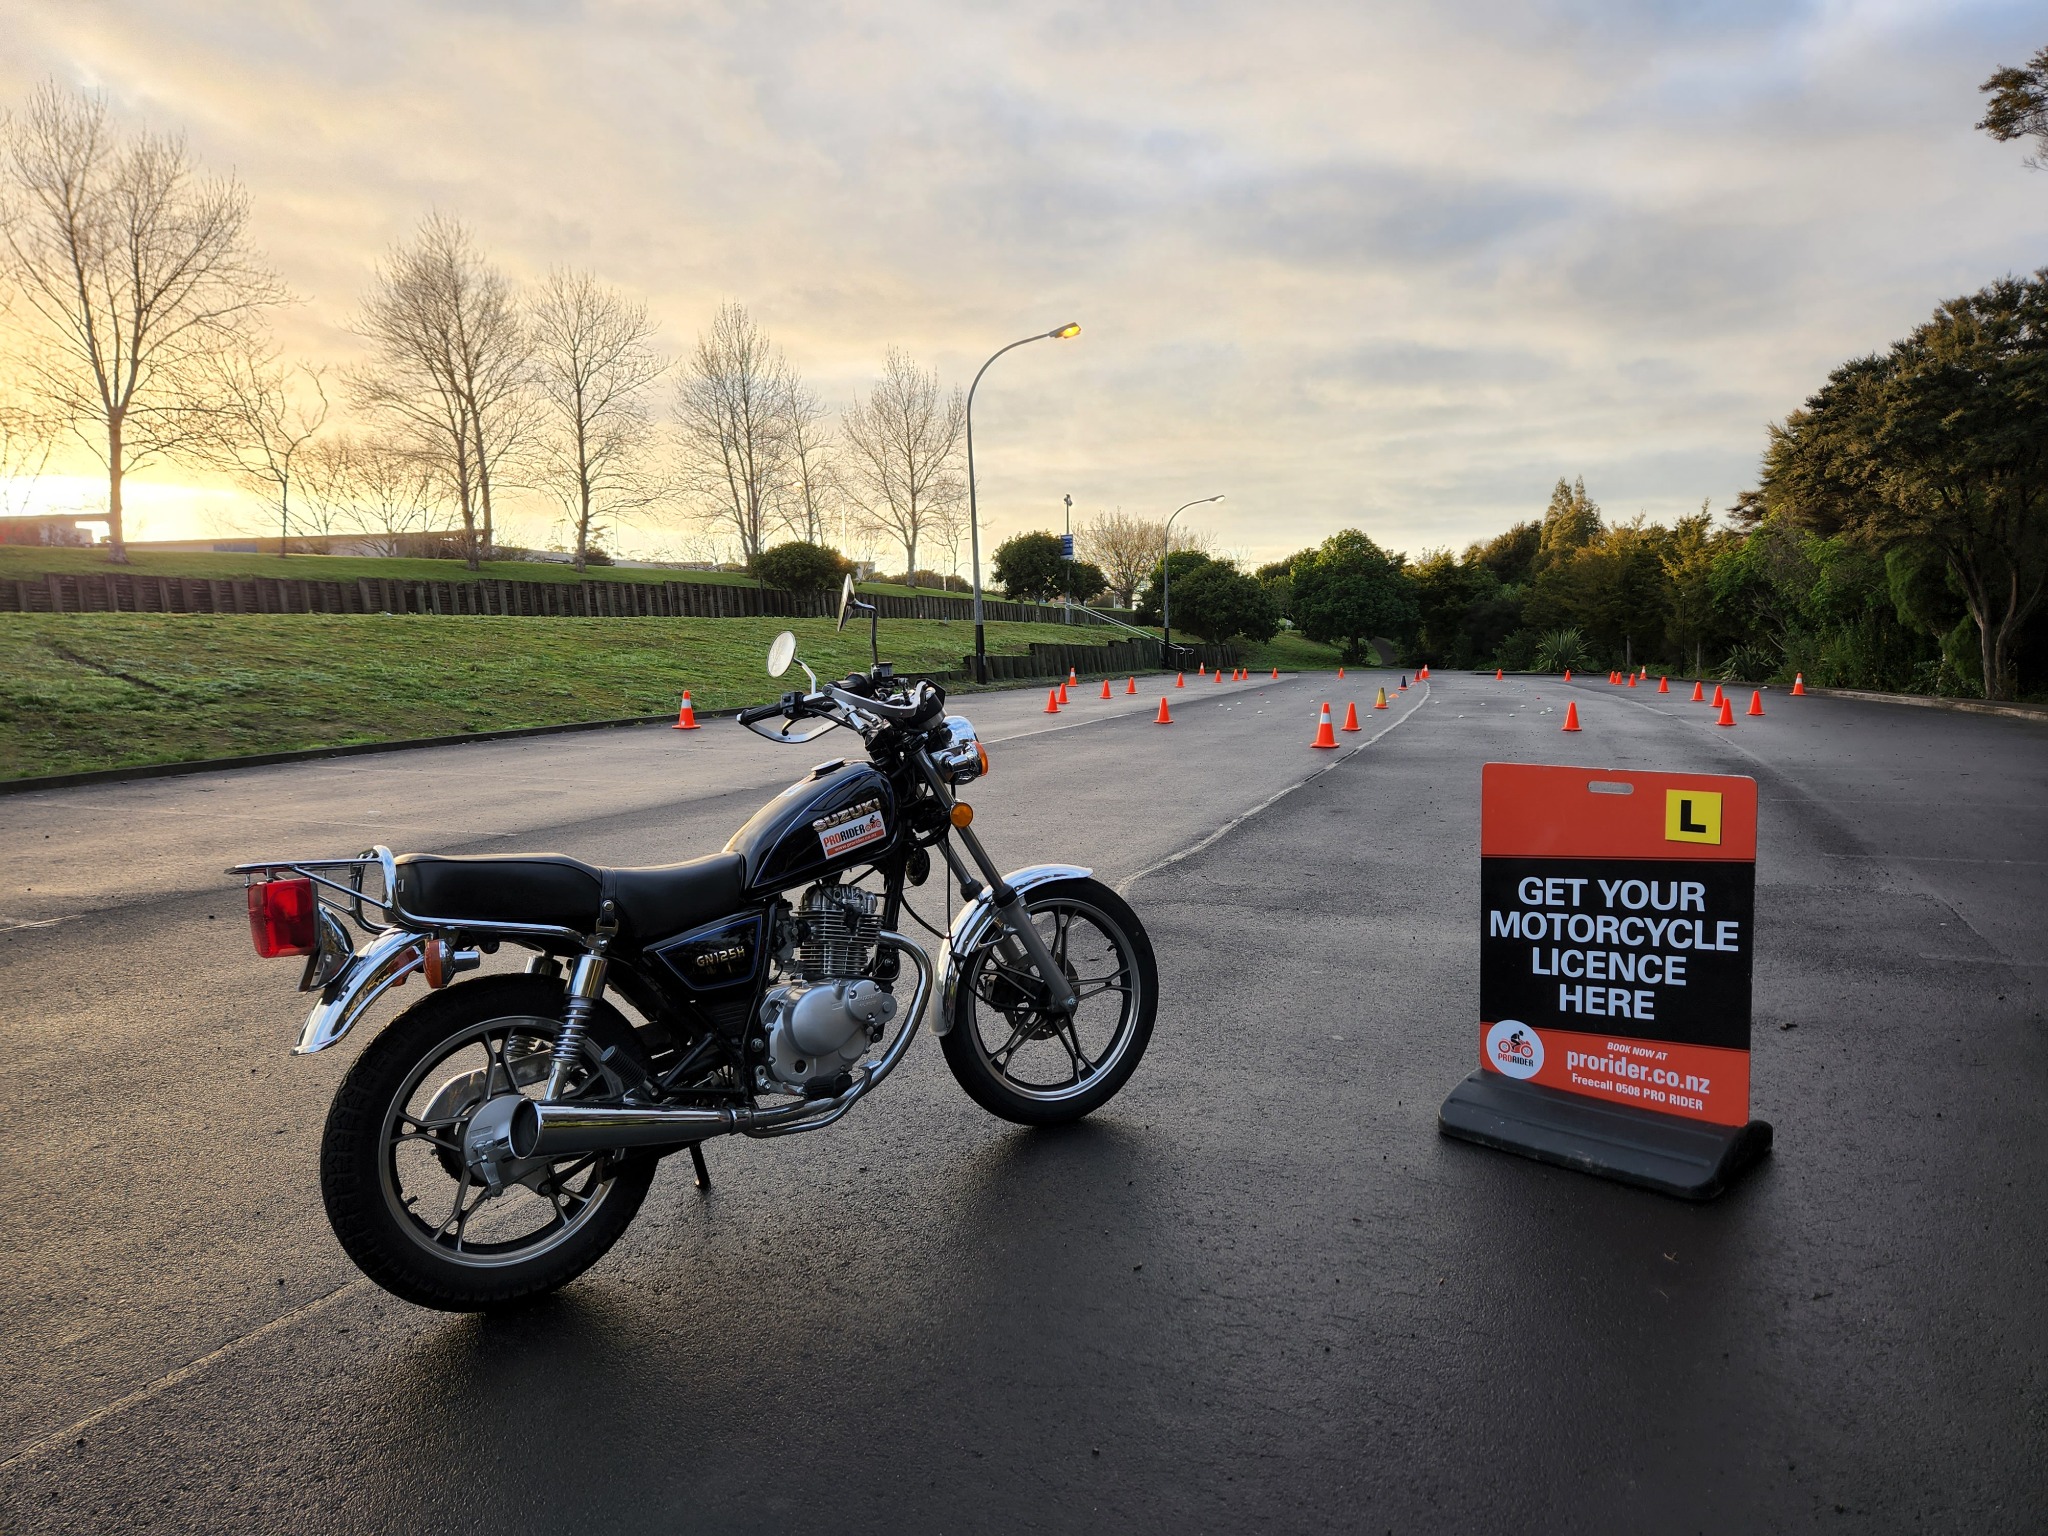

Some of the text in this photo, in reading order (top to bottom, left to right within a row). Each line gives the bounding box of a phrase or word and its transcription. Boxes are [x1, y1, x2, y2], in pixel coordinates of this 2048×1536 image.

[812, 798, 881, 833] SUZUKI
[1680, 800, 1706, 833] L
[823, 824, 866, 847] PRORIDER
[1518, 877, 1706, 912] GET YOUR
[1490, 910, 1739, 952] MOTORCYCLE
[696, 946, 745, 967] GN125H
[1532, 947, 1687, 986] LICENCE
[1559, 984, 1655, 1020] HERE
[1498, 1053, 1534, 1067] PRORIDER
[1607, 1042, 1668, 1061] BOOK NOW AT
[1567, 1050, 1710, 1094] prorider.co.nz
[1571, 1072, 1703, 1111] Freecall 0508 PRO RIDER
